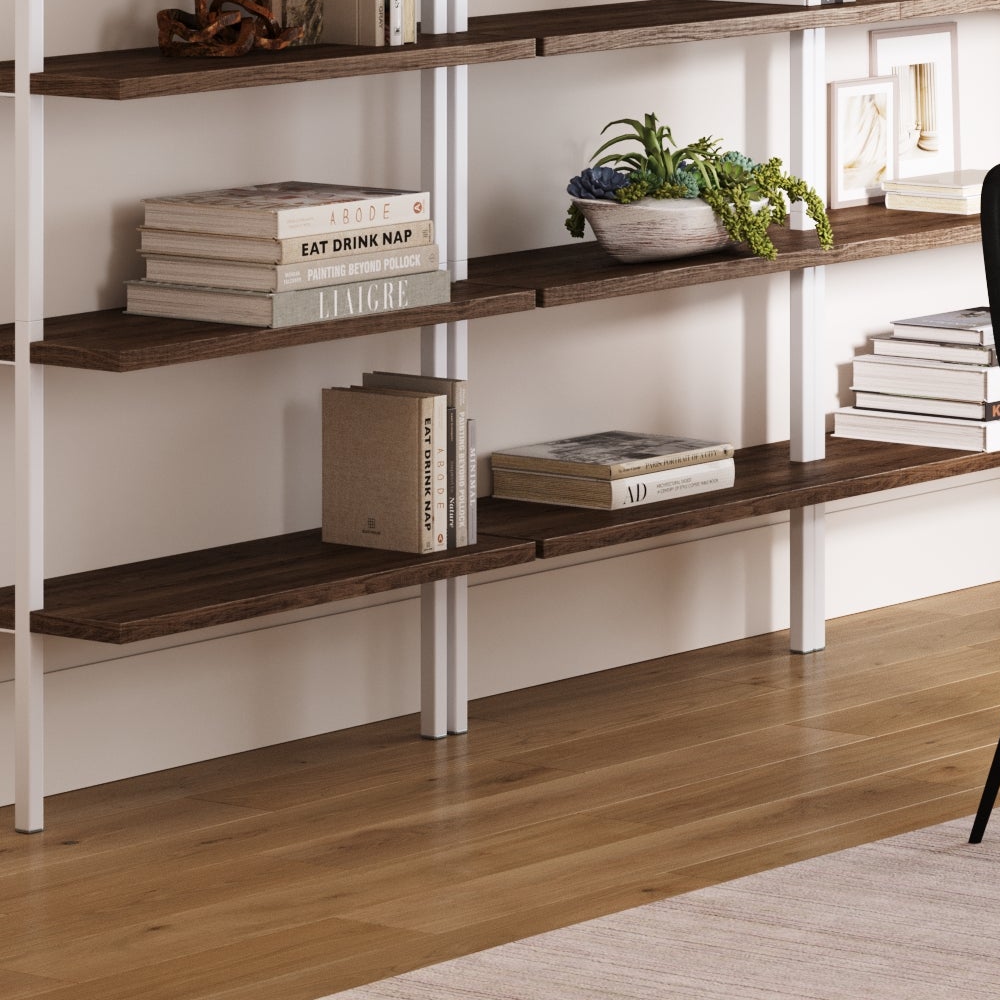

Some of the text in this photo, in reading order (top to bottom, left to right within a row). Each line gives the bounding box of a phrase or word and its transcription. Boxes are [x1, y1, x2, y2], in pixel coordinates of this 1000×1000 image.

[330, 203, 391, 226] ABODE
[301, 240, 328, 257] EAT
[333, 234, 378, 252] DRINK
[382, 229, 412, 246] NAP
[307, 254, 421, 281] PAINTING BEYOND POLLOCK
[319, 280, 409, 319] LIAIGRE
[457, 411, 465, 450] PAINTING
[424, 449, 432, 497] DRINK
[436, 448, 445, 509] ABODE
[623, 483, 647, 504] AD
